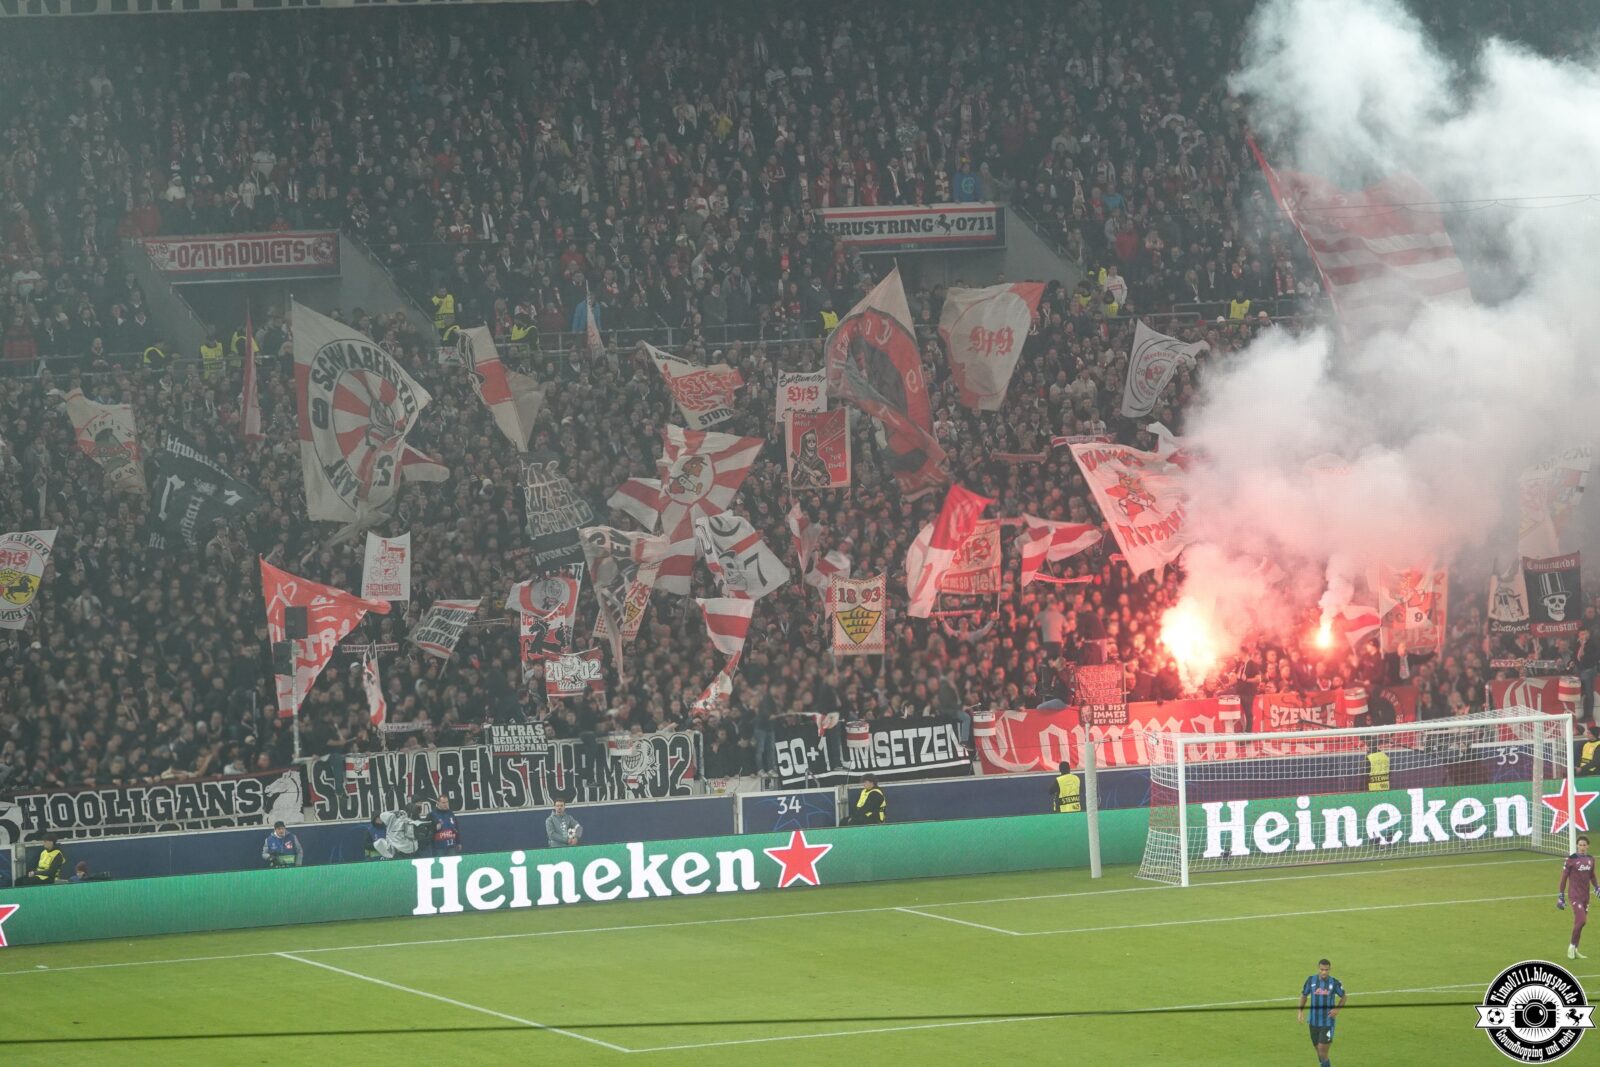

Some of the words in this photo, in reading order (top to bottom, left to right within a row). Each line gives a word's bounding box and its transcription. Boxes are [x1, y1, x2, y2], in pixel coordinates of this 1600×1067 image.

[825, 218, 934, 236] BRUSTRING
[955, 216, 994, 232] 0711
[1490, 620, 1531, 635] Stuttgart
[1536, 621, 1579, 634] Cannstatt
[1108, 703, 1127, 711] BIST
[1269, 704, 1322, 728] SZENE
[491, 723, 545, 737] ULTRAS
[493, 735, 546, 745] BEDEUTET
[494, 743, 549, 752] WIDERSTAND
[775, 736, 831, 777] 50+1
[840, 723, 969, 770] UMSETZEN
[1496, 747, 1519, 765] 35
[16, 780, 265, 831] HOOLIGANS
[776, 795, 802, 815] 34
[1201, 788, 1534, 859] Heineken
[411, 842, 761, 915] Heineken
